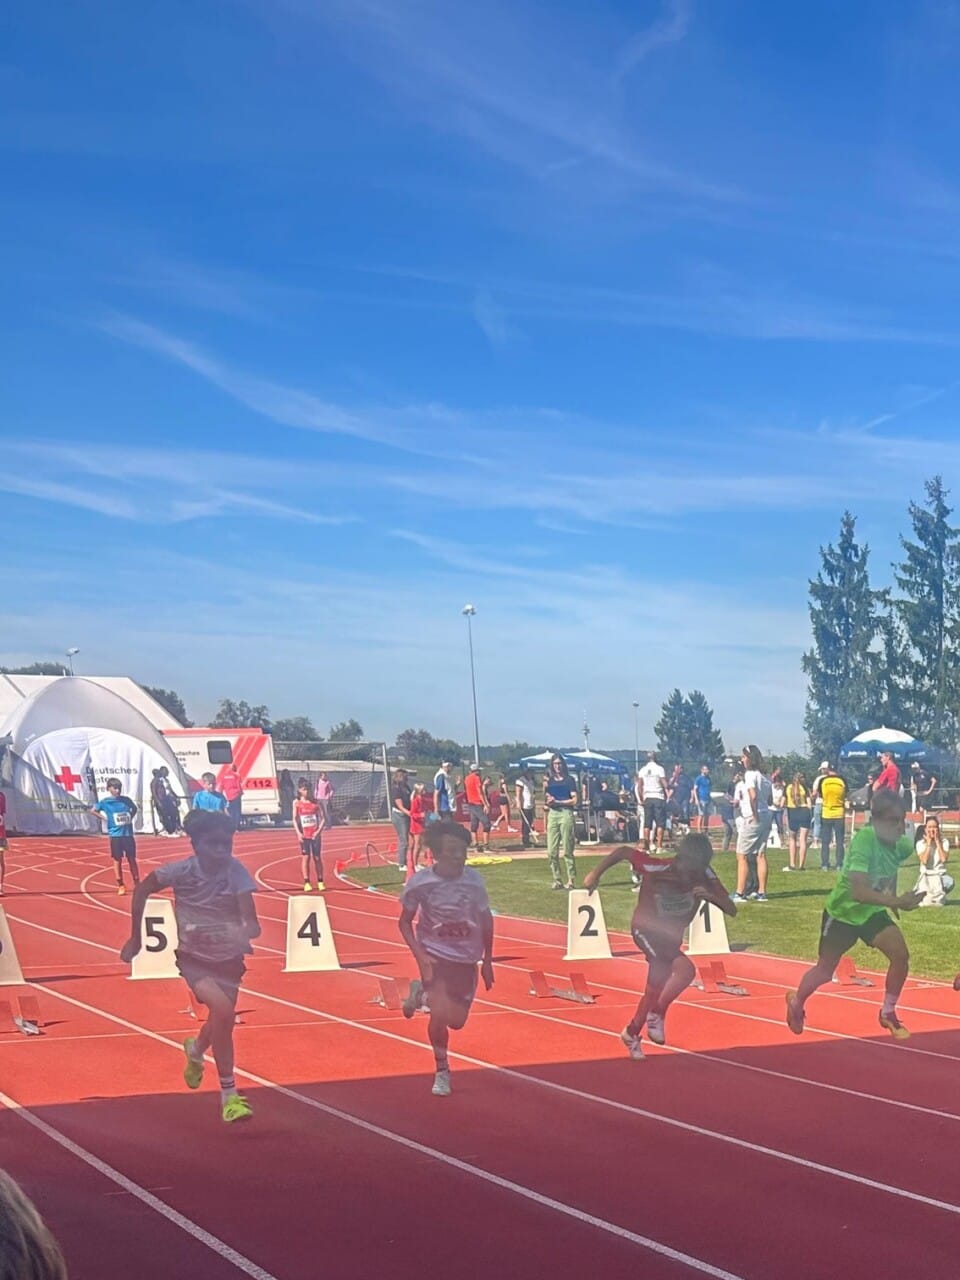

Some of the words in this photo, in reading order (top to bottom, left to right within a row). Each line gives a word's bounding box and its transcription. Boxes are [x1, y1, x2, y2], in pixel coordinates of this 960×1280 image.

[253, 780, 272, 788] 112
[769, 836, 774, 845] 1
[297, 912, 321, 947] 4
[578, 905, 599, 937] 2
[699, 900, 711, 933] 1
[145, 916, 168, 952] 5
